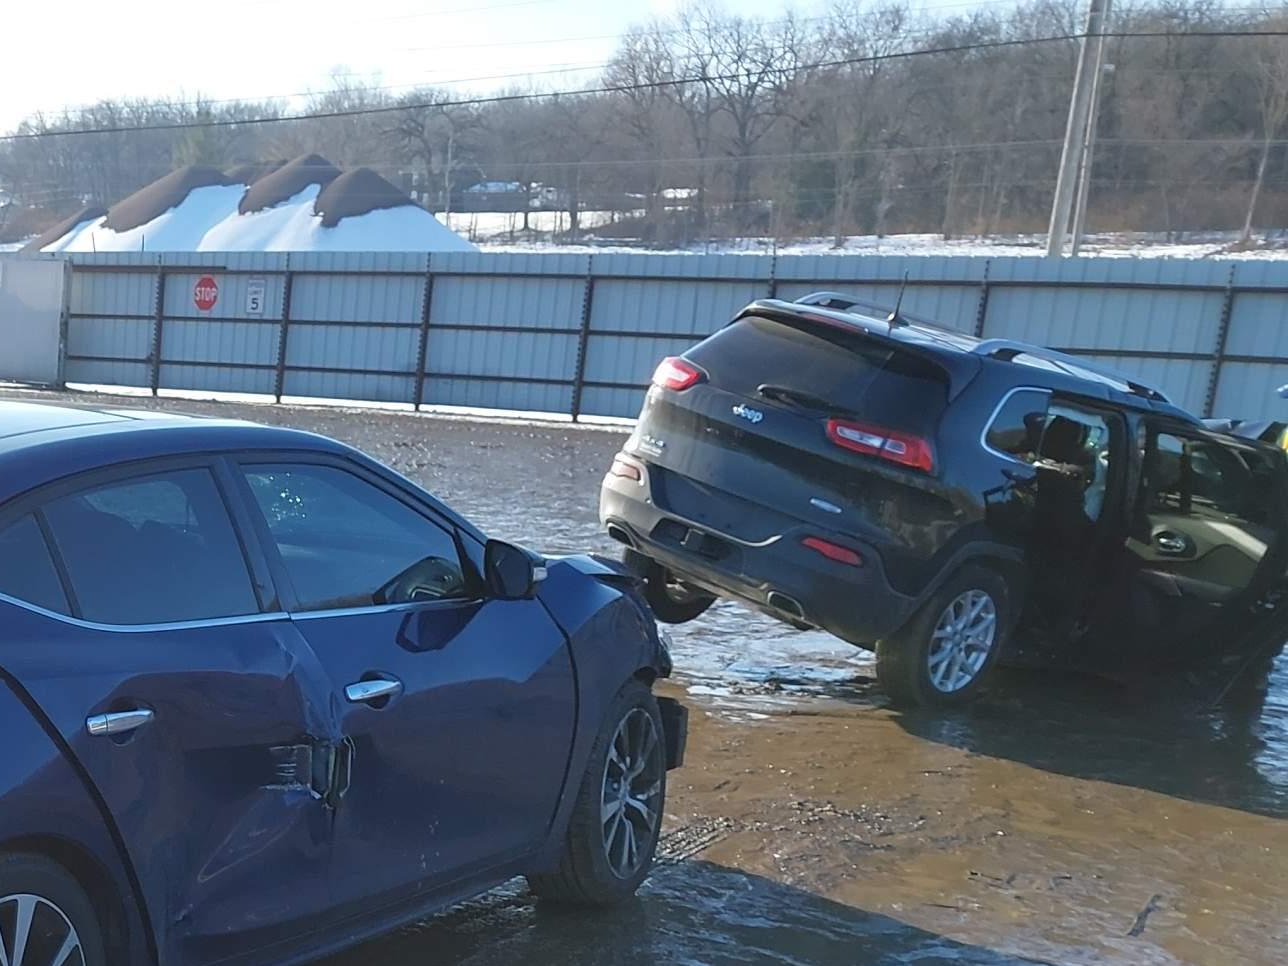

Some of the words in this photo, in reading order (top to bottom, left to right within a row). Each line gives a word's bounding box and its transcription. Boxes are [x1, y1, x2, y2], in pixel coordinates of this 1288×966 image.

[196, 287, 217, 301] STOP
[251, 297, 259, 310] 5
[733, 404, 763, 423] Jeep
